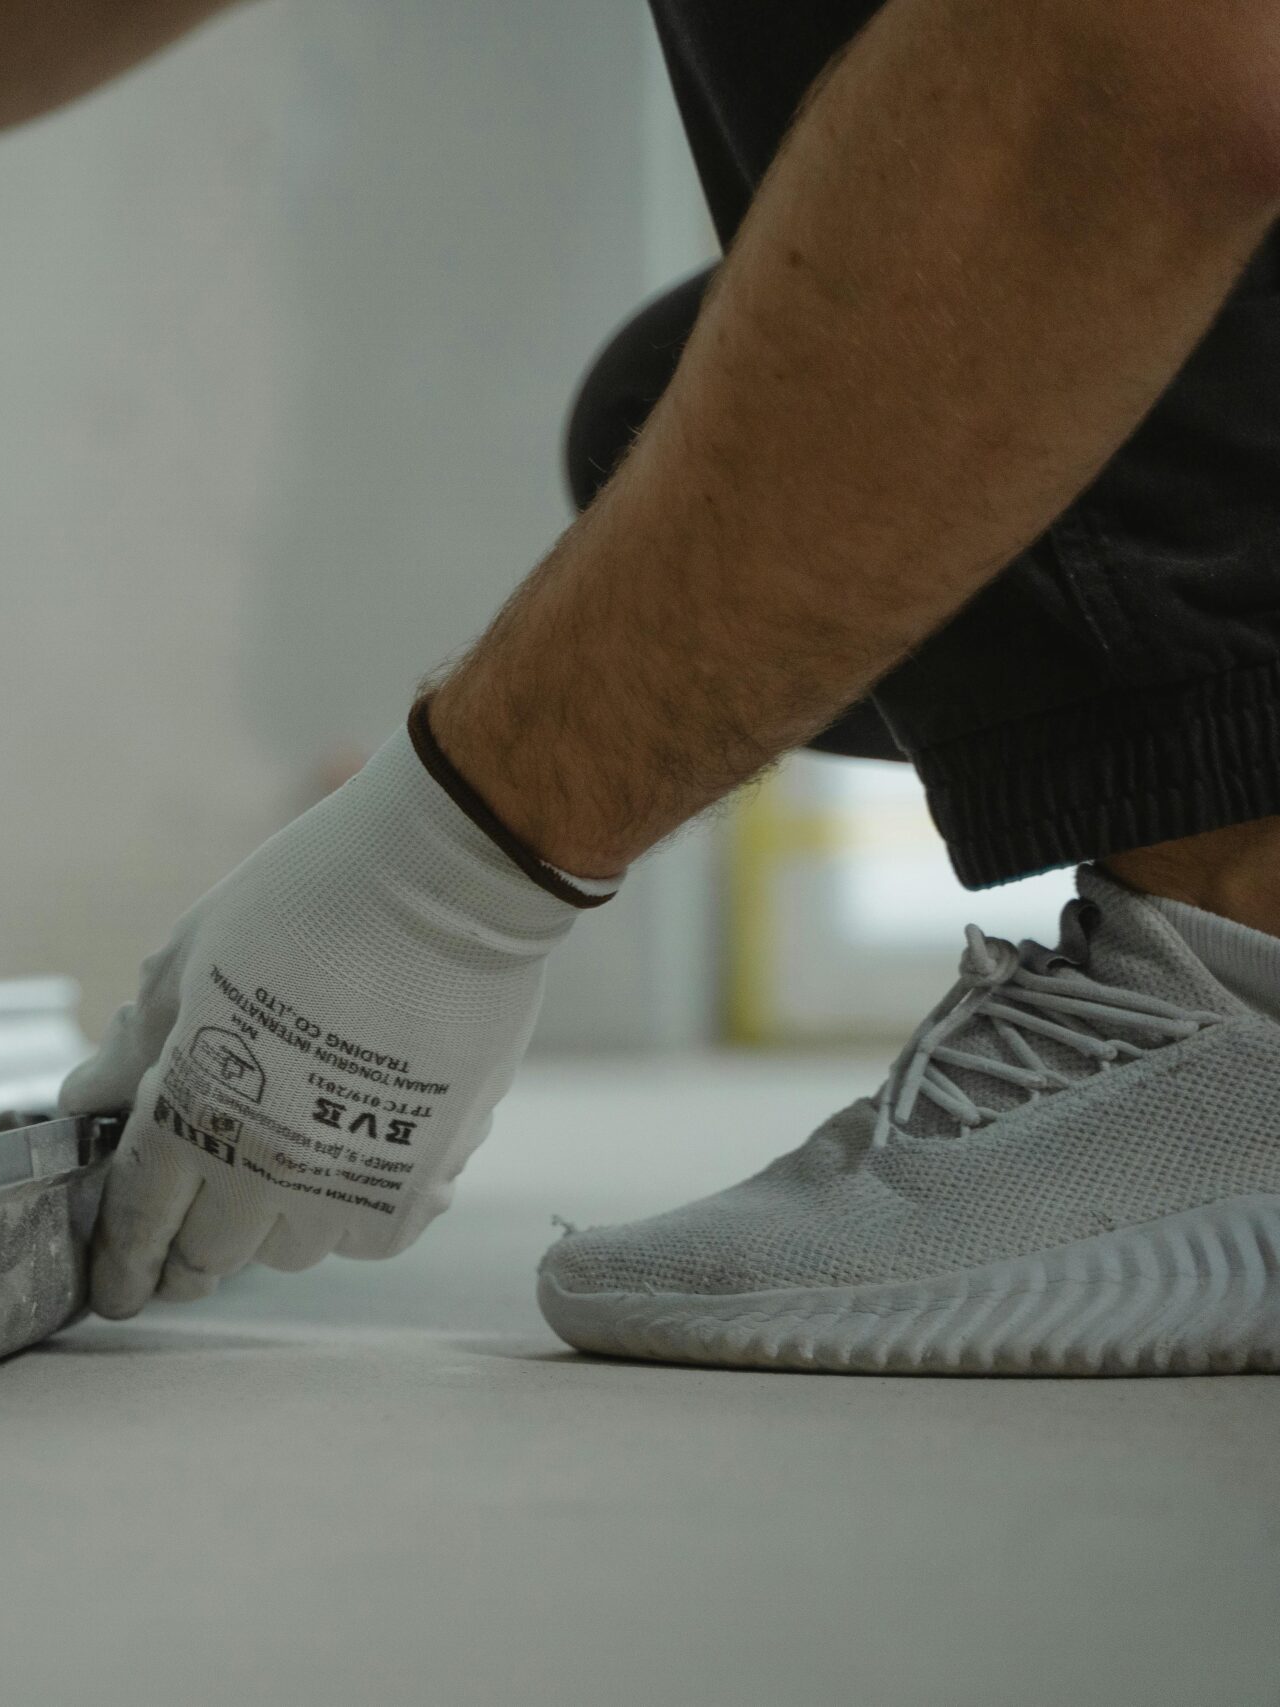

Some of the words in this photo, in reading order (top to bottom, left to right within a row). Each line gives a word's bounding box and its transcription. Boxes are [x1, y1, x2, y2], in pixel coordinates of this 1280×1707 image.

[210, 964, 312, 1051] INTERNATIONAL
[313, 1047, 390, 1087] TONGRUN
[325, 1032, 410, 1073] TRADING
[308, 1072, 381, 1108] 019/2011
[393, 1076, 450, 1095] HUAIAN
[312, 1097, 417, 1146] BVB
[336, 1168, 404, 1190] МОДЕЛЬ:
[360, 1153, 415, 1173] РАЗМЕР:
[325, 1188, 396, 1215] ПЕРЧАТКИ
